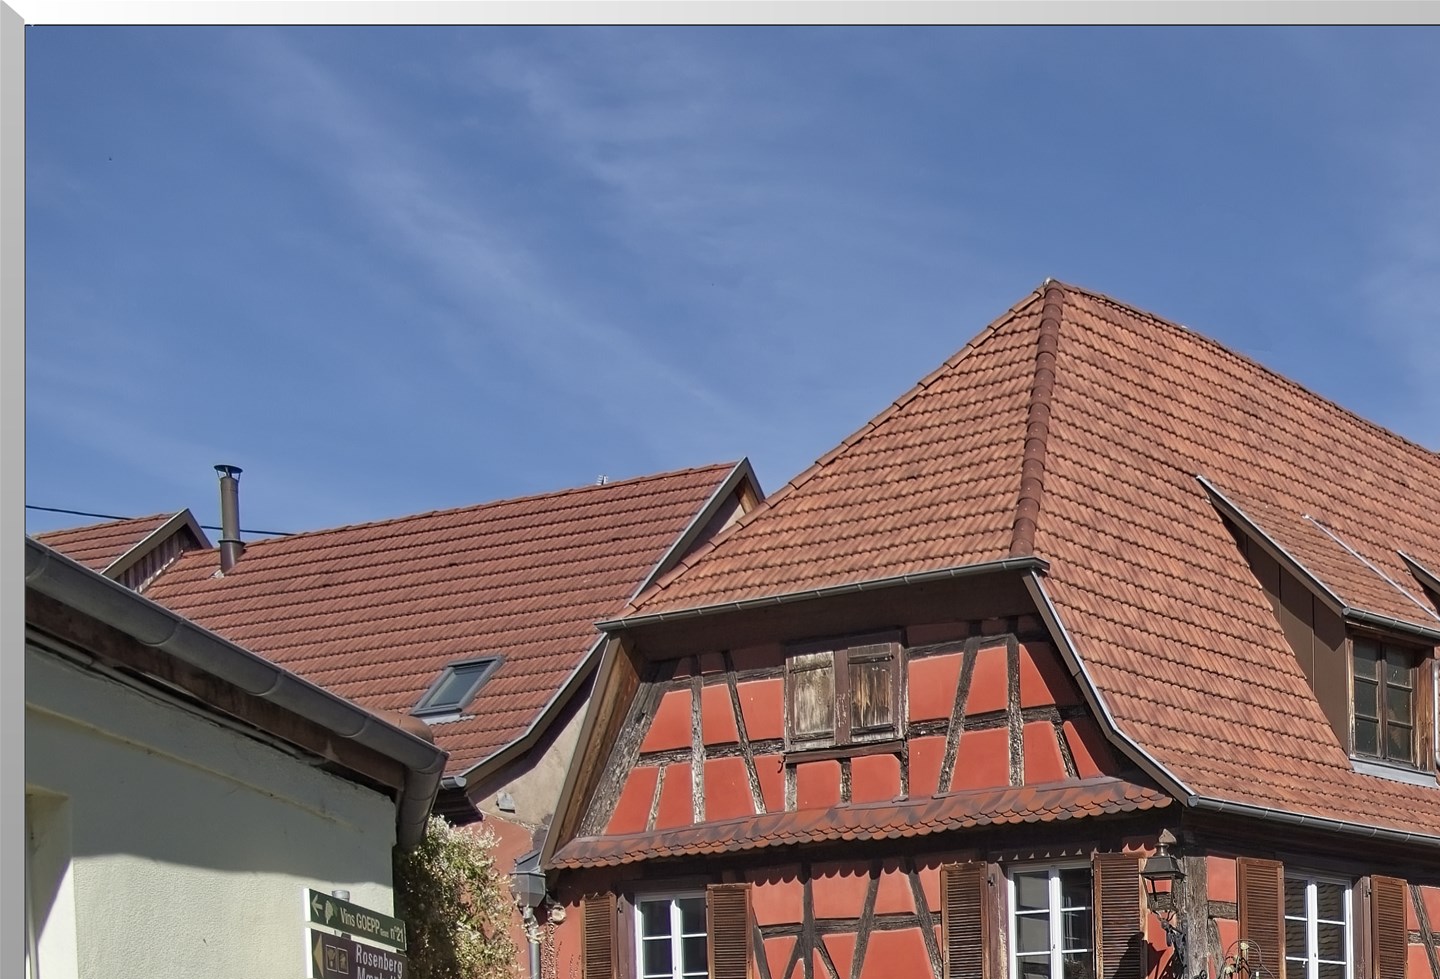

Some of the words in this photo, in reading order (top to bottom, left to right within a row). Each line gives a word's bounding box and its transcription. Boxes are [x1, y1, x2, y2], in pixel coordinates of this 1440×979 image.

[340, 907, 355, 927] Vins
[356, 913, 380, 934] GOEPP
[356, 944, 403, 979] Rosenberg
